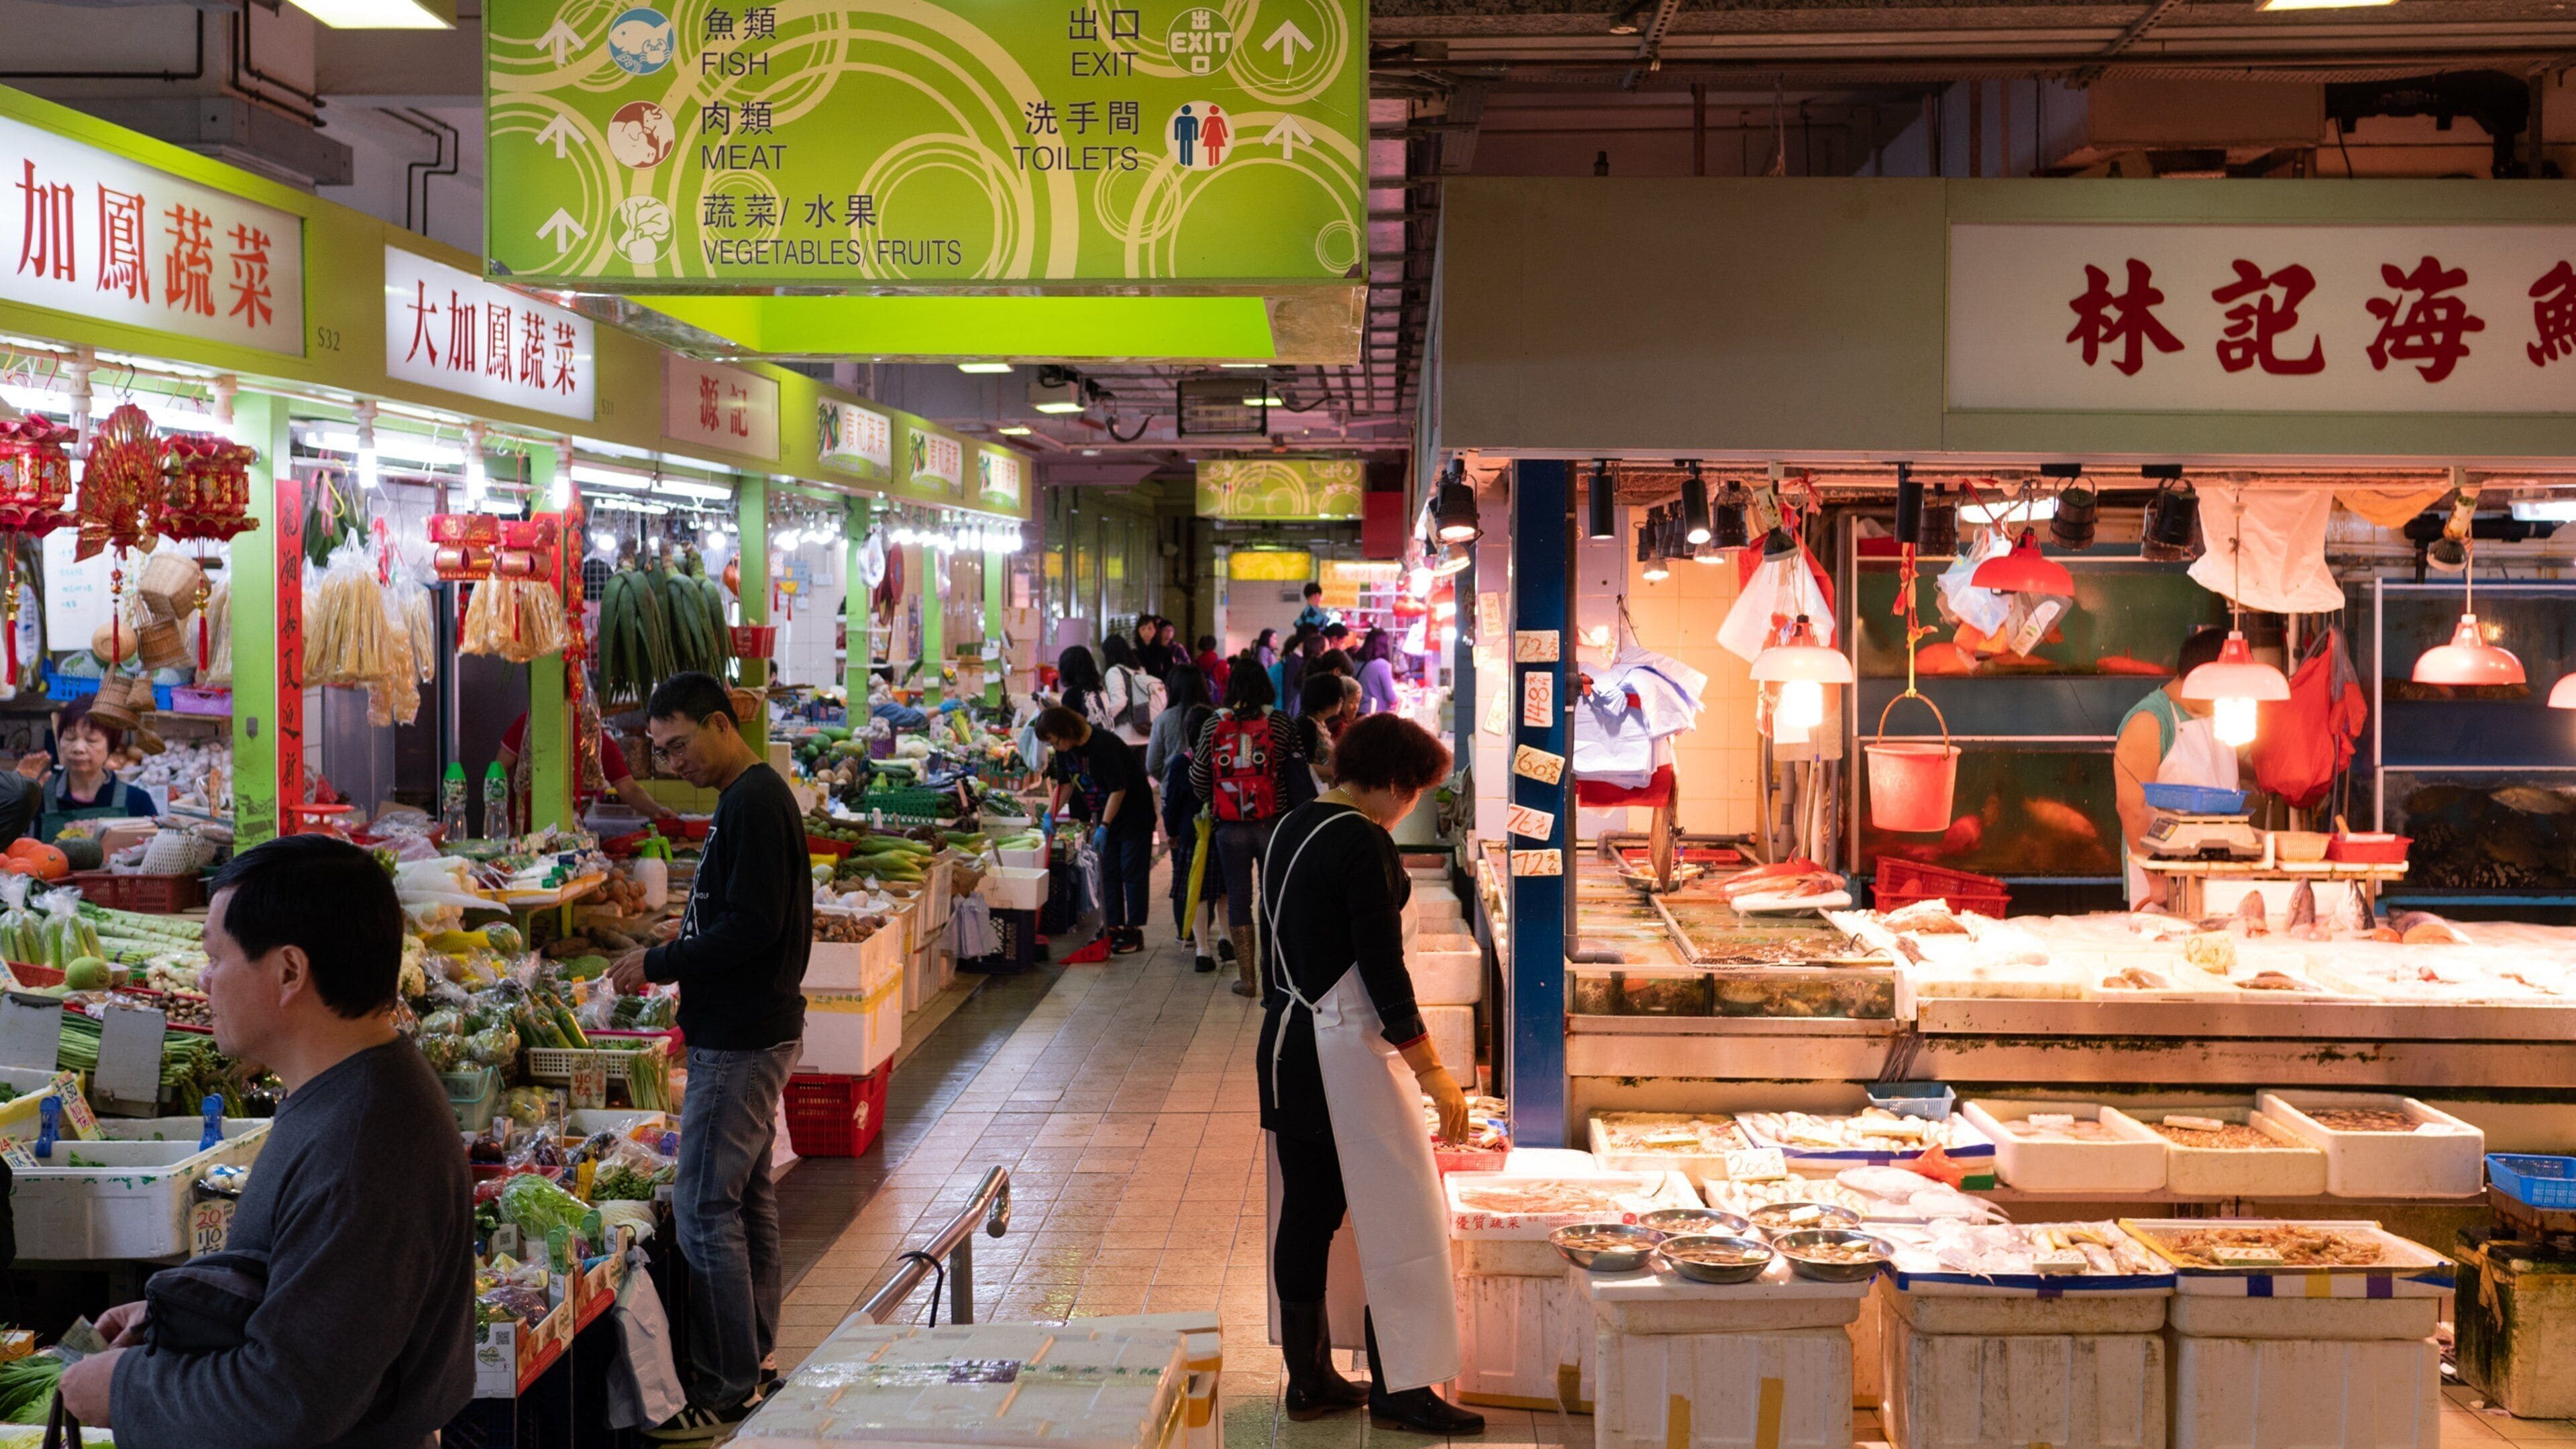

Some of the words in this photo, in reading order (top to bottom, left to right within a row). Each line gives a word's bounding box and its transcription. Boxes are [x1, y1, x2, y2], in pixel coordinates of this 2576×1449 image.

[704, 7, 777, 41] 魚類
[1069, 7, 1140, 42] 出口
[1171, 32, 1232, 53] EXIT
[702, 52, 768, 76] FISH
[1071, 52, 1139, 76] EXIT
[702, 101, 773, 136] 肉類
[1024, 100, 1139, 136] 洗手間
[702, 145, 788, 170] MEAT
[1013, 146, 1138, 171] TOILETS
[15, 158, 273, 329] 加鳳蔬菜
[704, 239, 869, 268] VEGETABLES/
[877, 239, 962, 266] FRUITS
[318, 326, 340, 352] S32
[407, 280, 577, 396] 大加鳳蔬菜
[700, 374, 749, 437] 源記
[1515, 636, 1546, 658] 72
[1524, 686, 1550, 724] 148
[1517, 751, 1547, 776] 60
[1511, 851, 1544, 875] 72
[195, 1210, 222, 1228] 20
